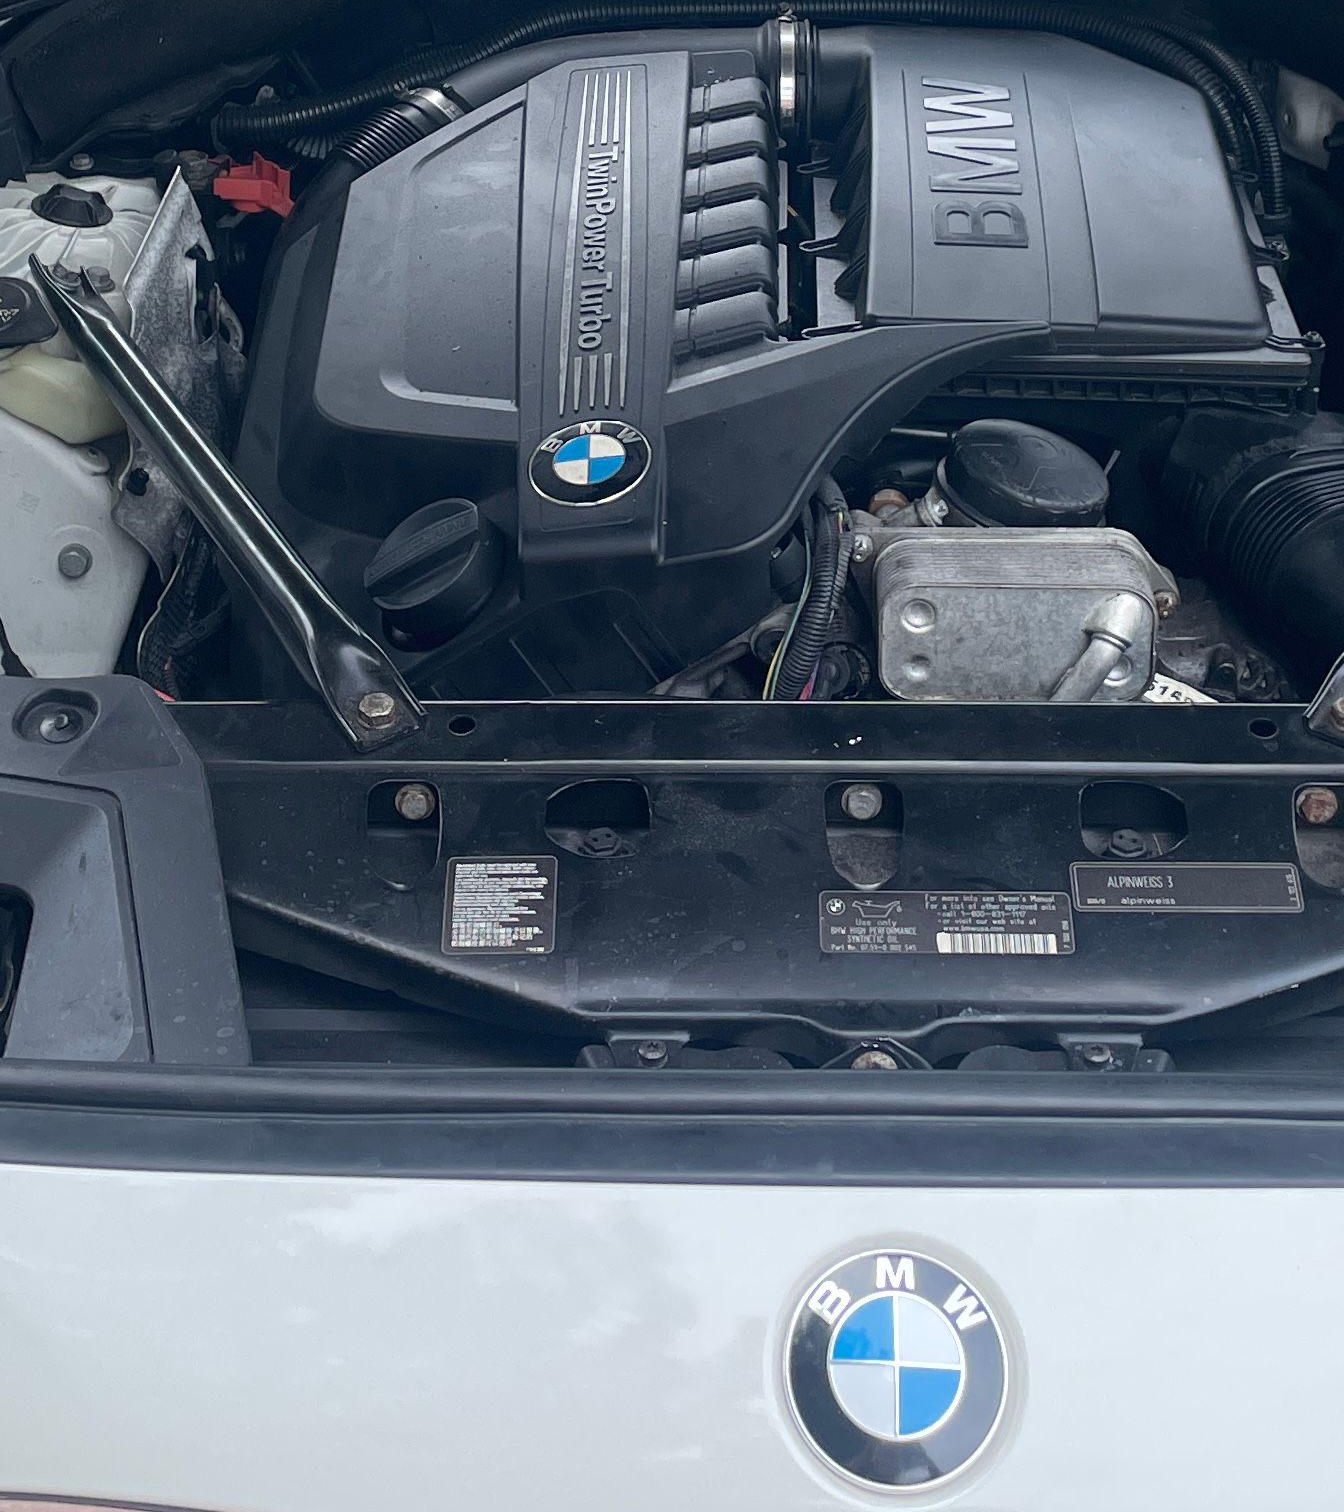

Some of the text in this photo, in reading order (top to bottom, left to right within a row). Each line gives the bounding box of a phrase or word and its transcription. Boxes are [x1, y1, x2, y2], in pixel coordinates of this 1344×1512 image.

[921, 76, 1029, 249] BMW
[540, 421, 642, 454] BMW
[1107, 876, 1174, 888] ALPINWEISS 3
[924, 893, 938, 902] For
[1120, 896, 1176, 906] alpinweiss
[877, 918, 897, 928] only
[869, 927, 917, 936] PERFORMANCE
[847, 935, 899, 943] SYNTHETIC OIL
[807, 1255, 988, 1332] BMW
